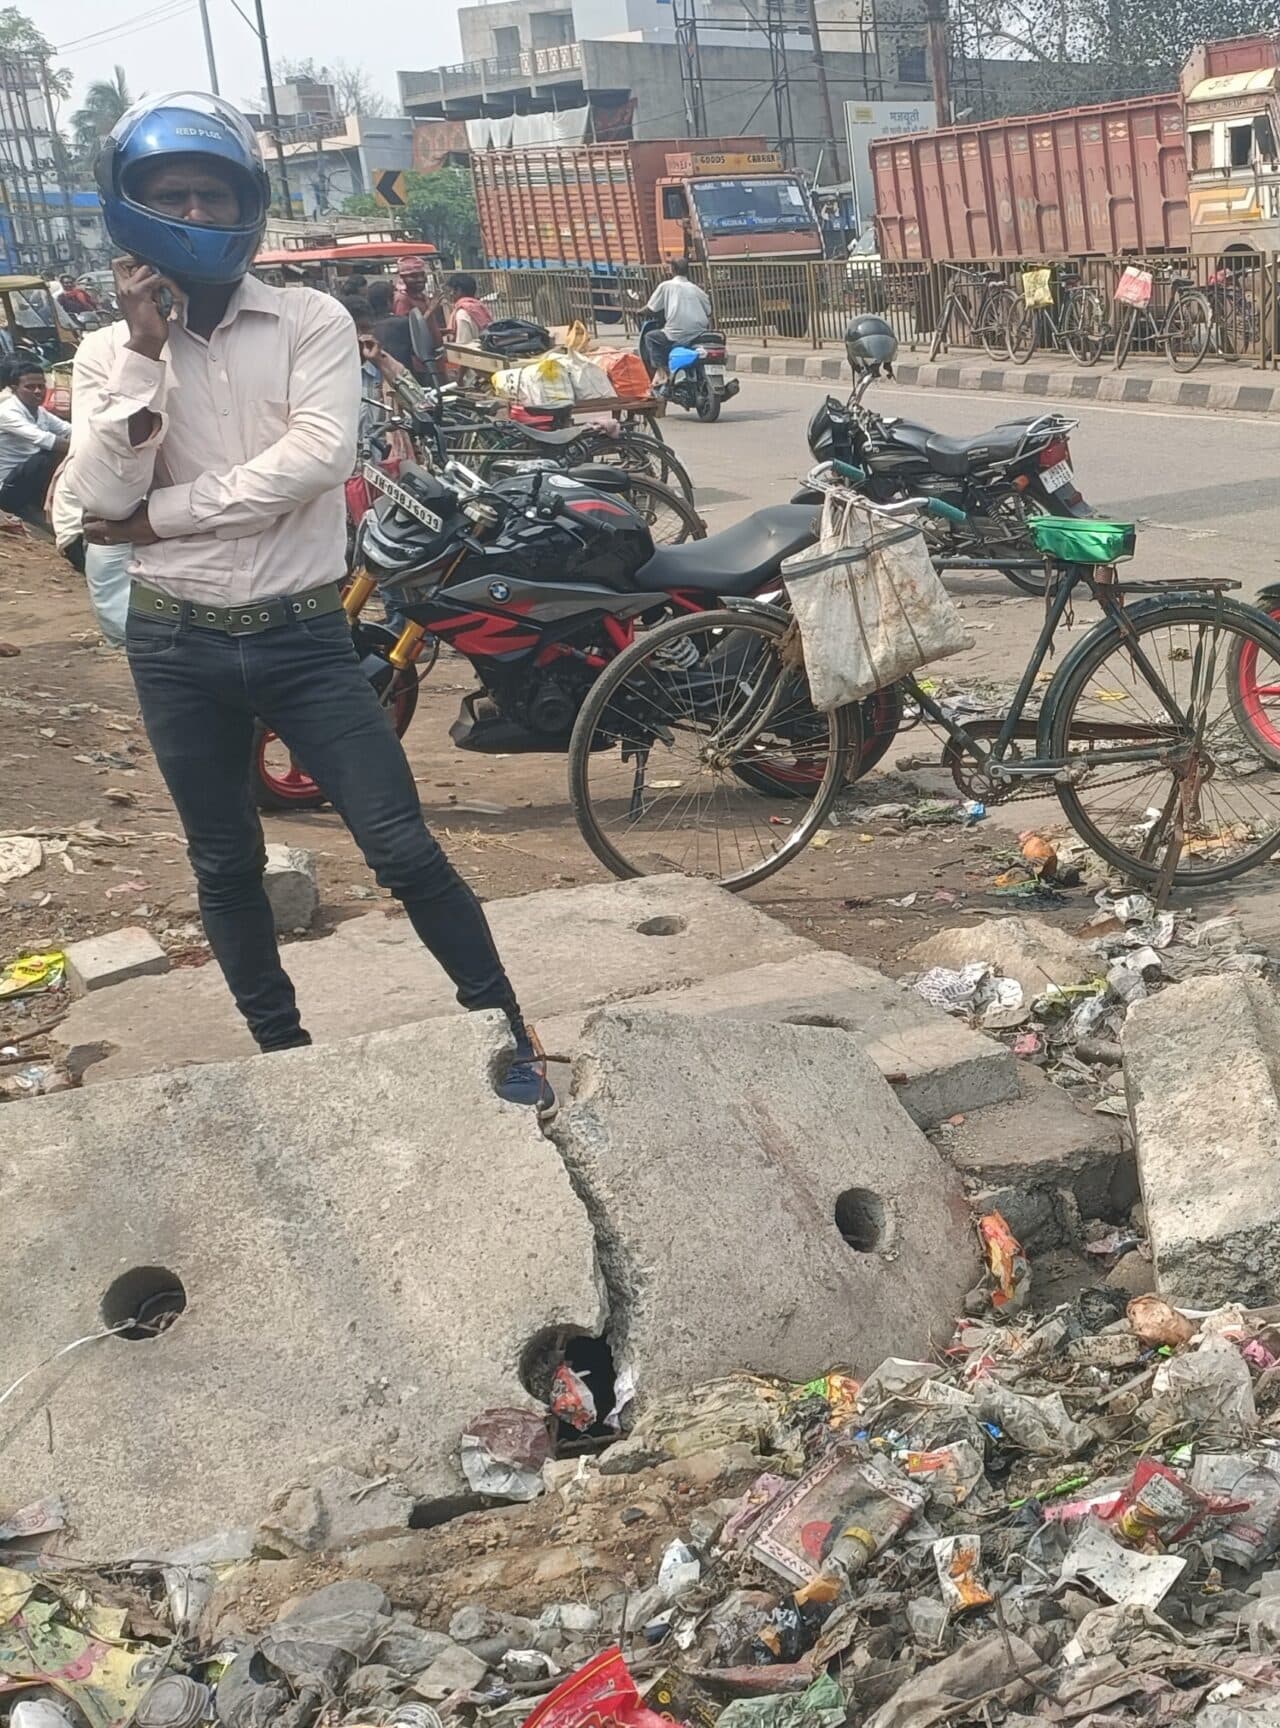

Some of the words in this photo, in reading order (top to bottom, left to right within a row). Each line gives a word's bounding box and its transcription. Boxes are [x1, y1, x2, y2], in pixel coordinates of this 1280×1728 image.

[175, 127, 197, 136] RED
[700, 155, 726, 164] GOODS
[747, 154, 776, 163] CARRIER
